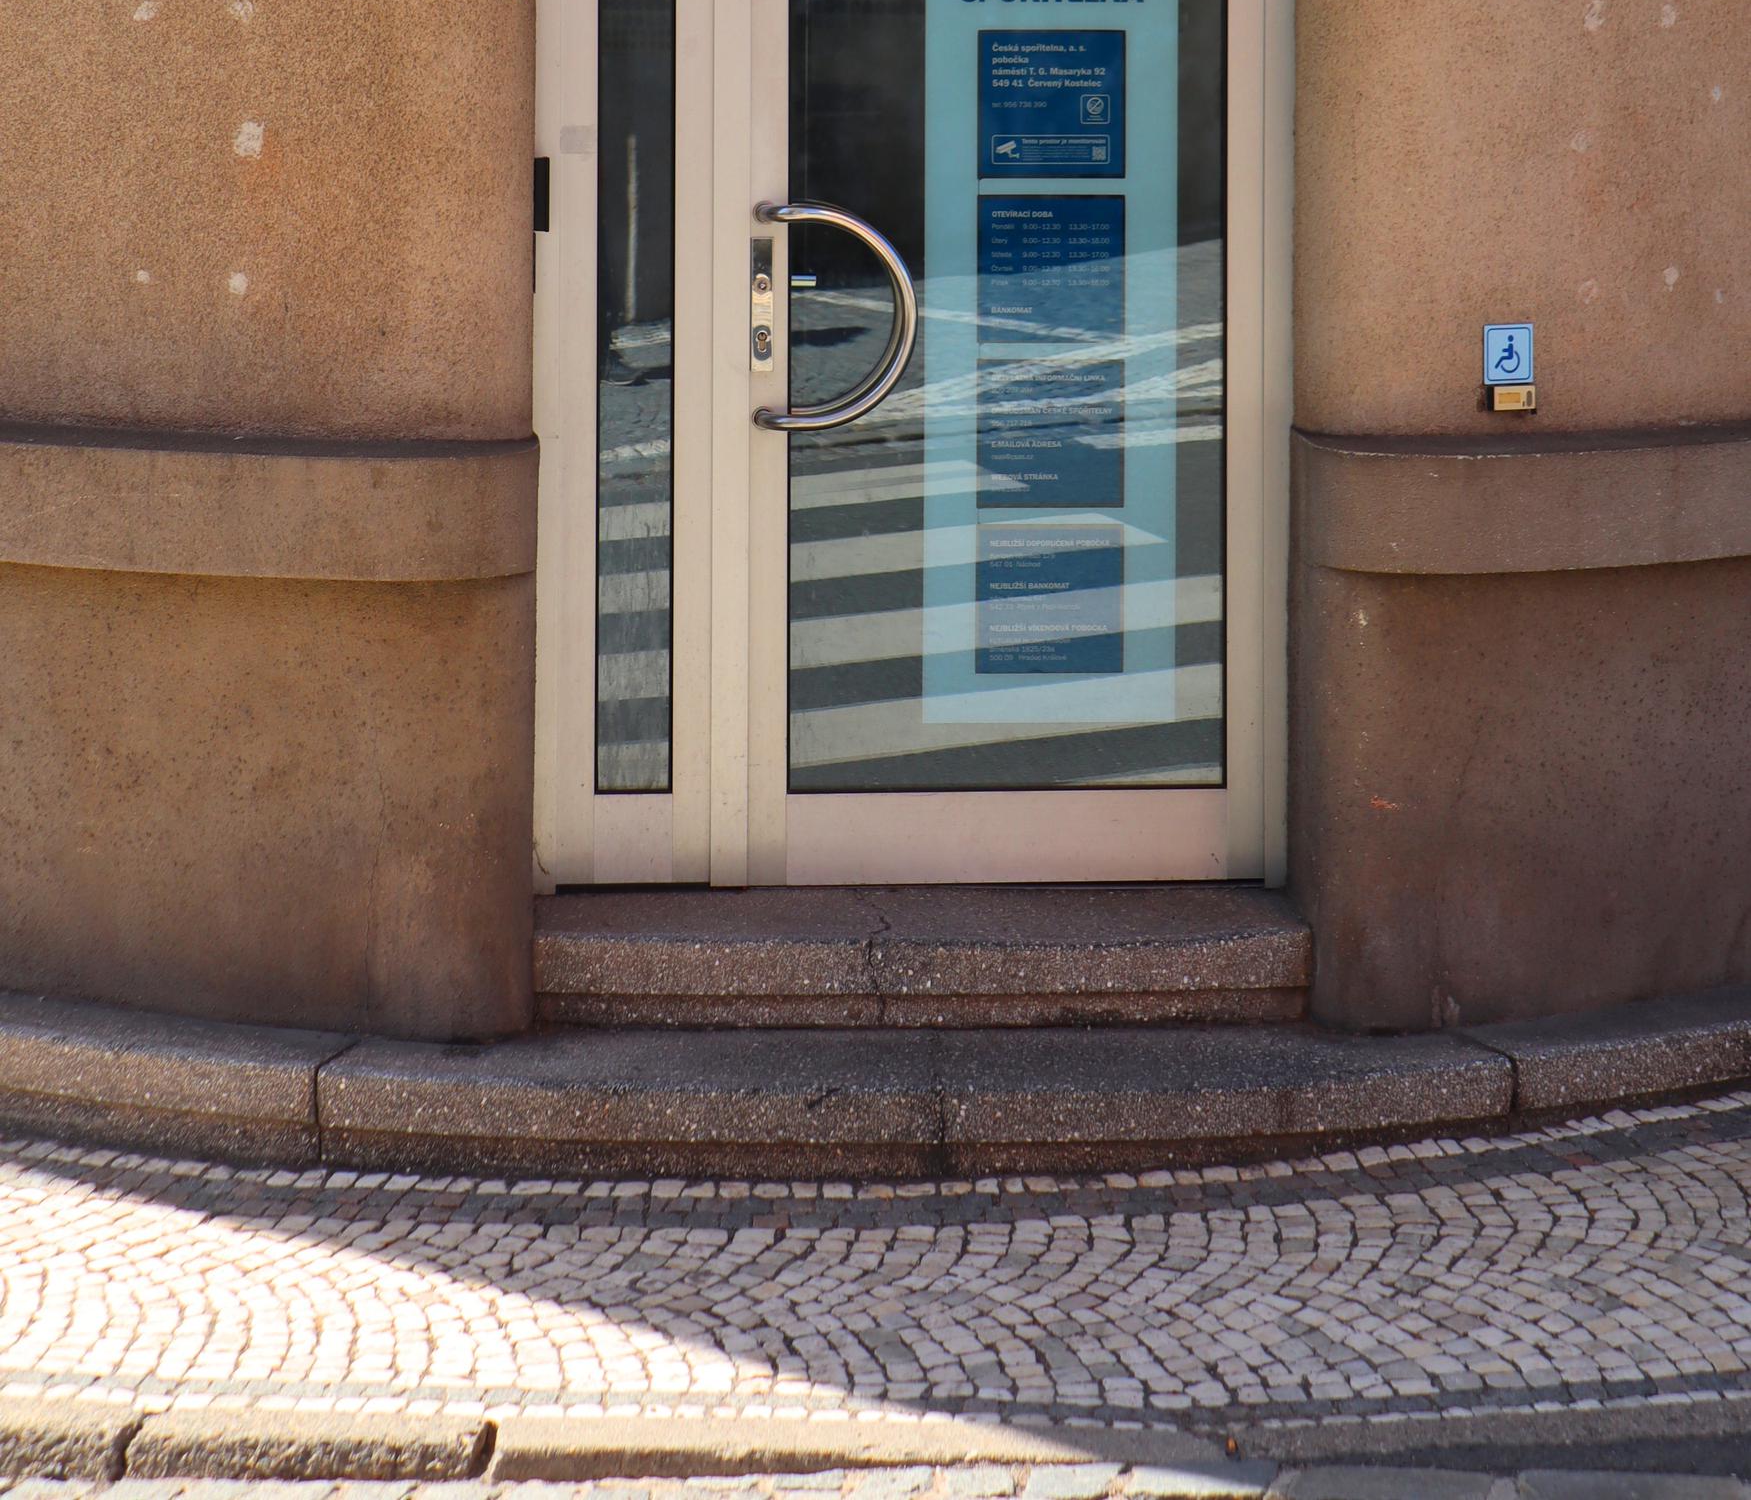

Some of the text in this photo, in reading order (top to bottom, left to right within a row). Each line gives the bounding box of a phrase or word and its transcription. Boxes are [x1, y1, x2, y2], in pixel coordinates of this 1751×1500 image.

[992, 43, 1020, 52] Česká
[992, 56, 1029, 65] pobočka
[1049, 67, 1092, 77] Masaryka
[1094, 67, 1106, 76] 92
[992, 78, 1103, 89] 549 41 Červený Kostelec
